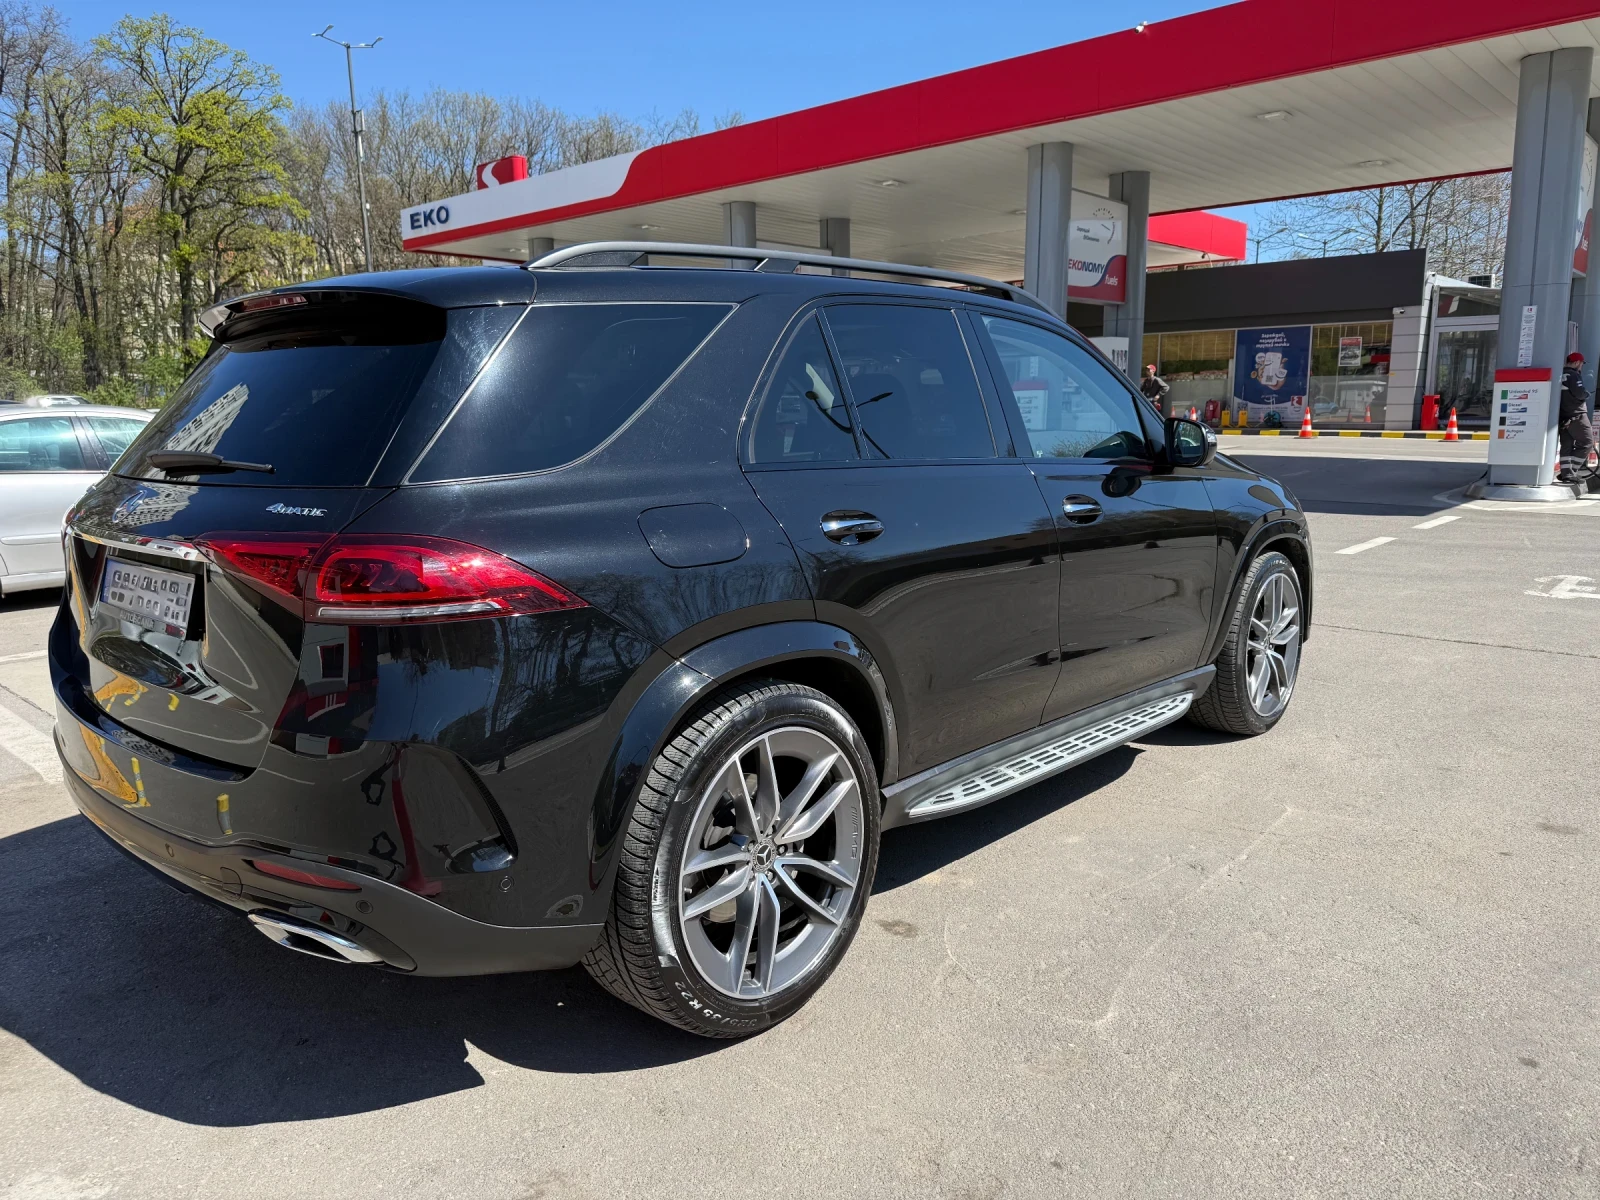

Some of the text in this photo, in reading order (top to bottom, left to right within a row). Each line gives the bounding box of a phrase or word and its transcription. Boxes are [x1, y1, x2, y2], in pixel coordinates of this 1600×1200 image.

[409, 205, 450, 230] EKO
[1068, 258, 1106, 274] EKONOMY
[1104, 274, 1118, 286] fuels
[265, 502, 328, 517] 4MATIC
